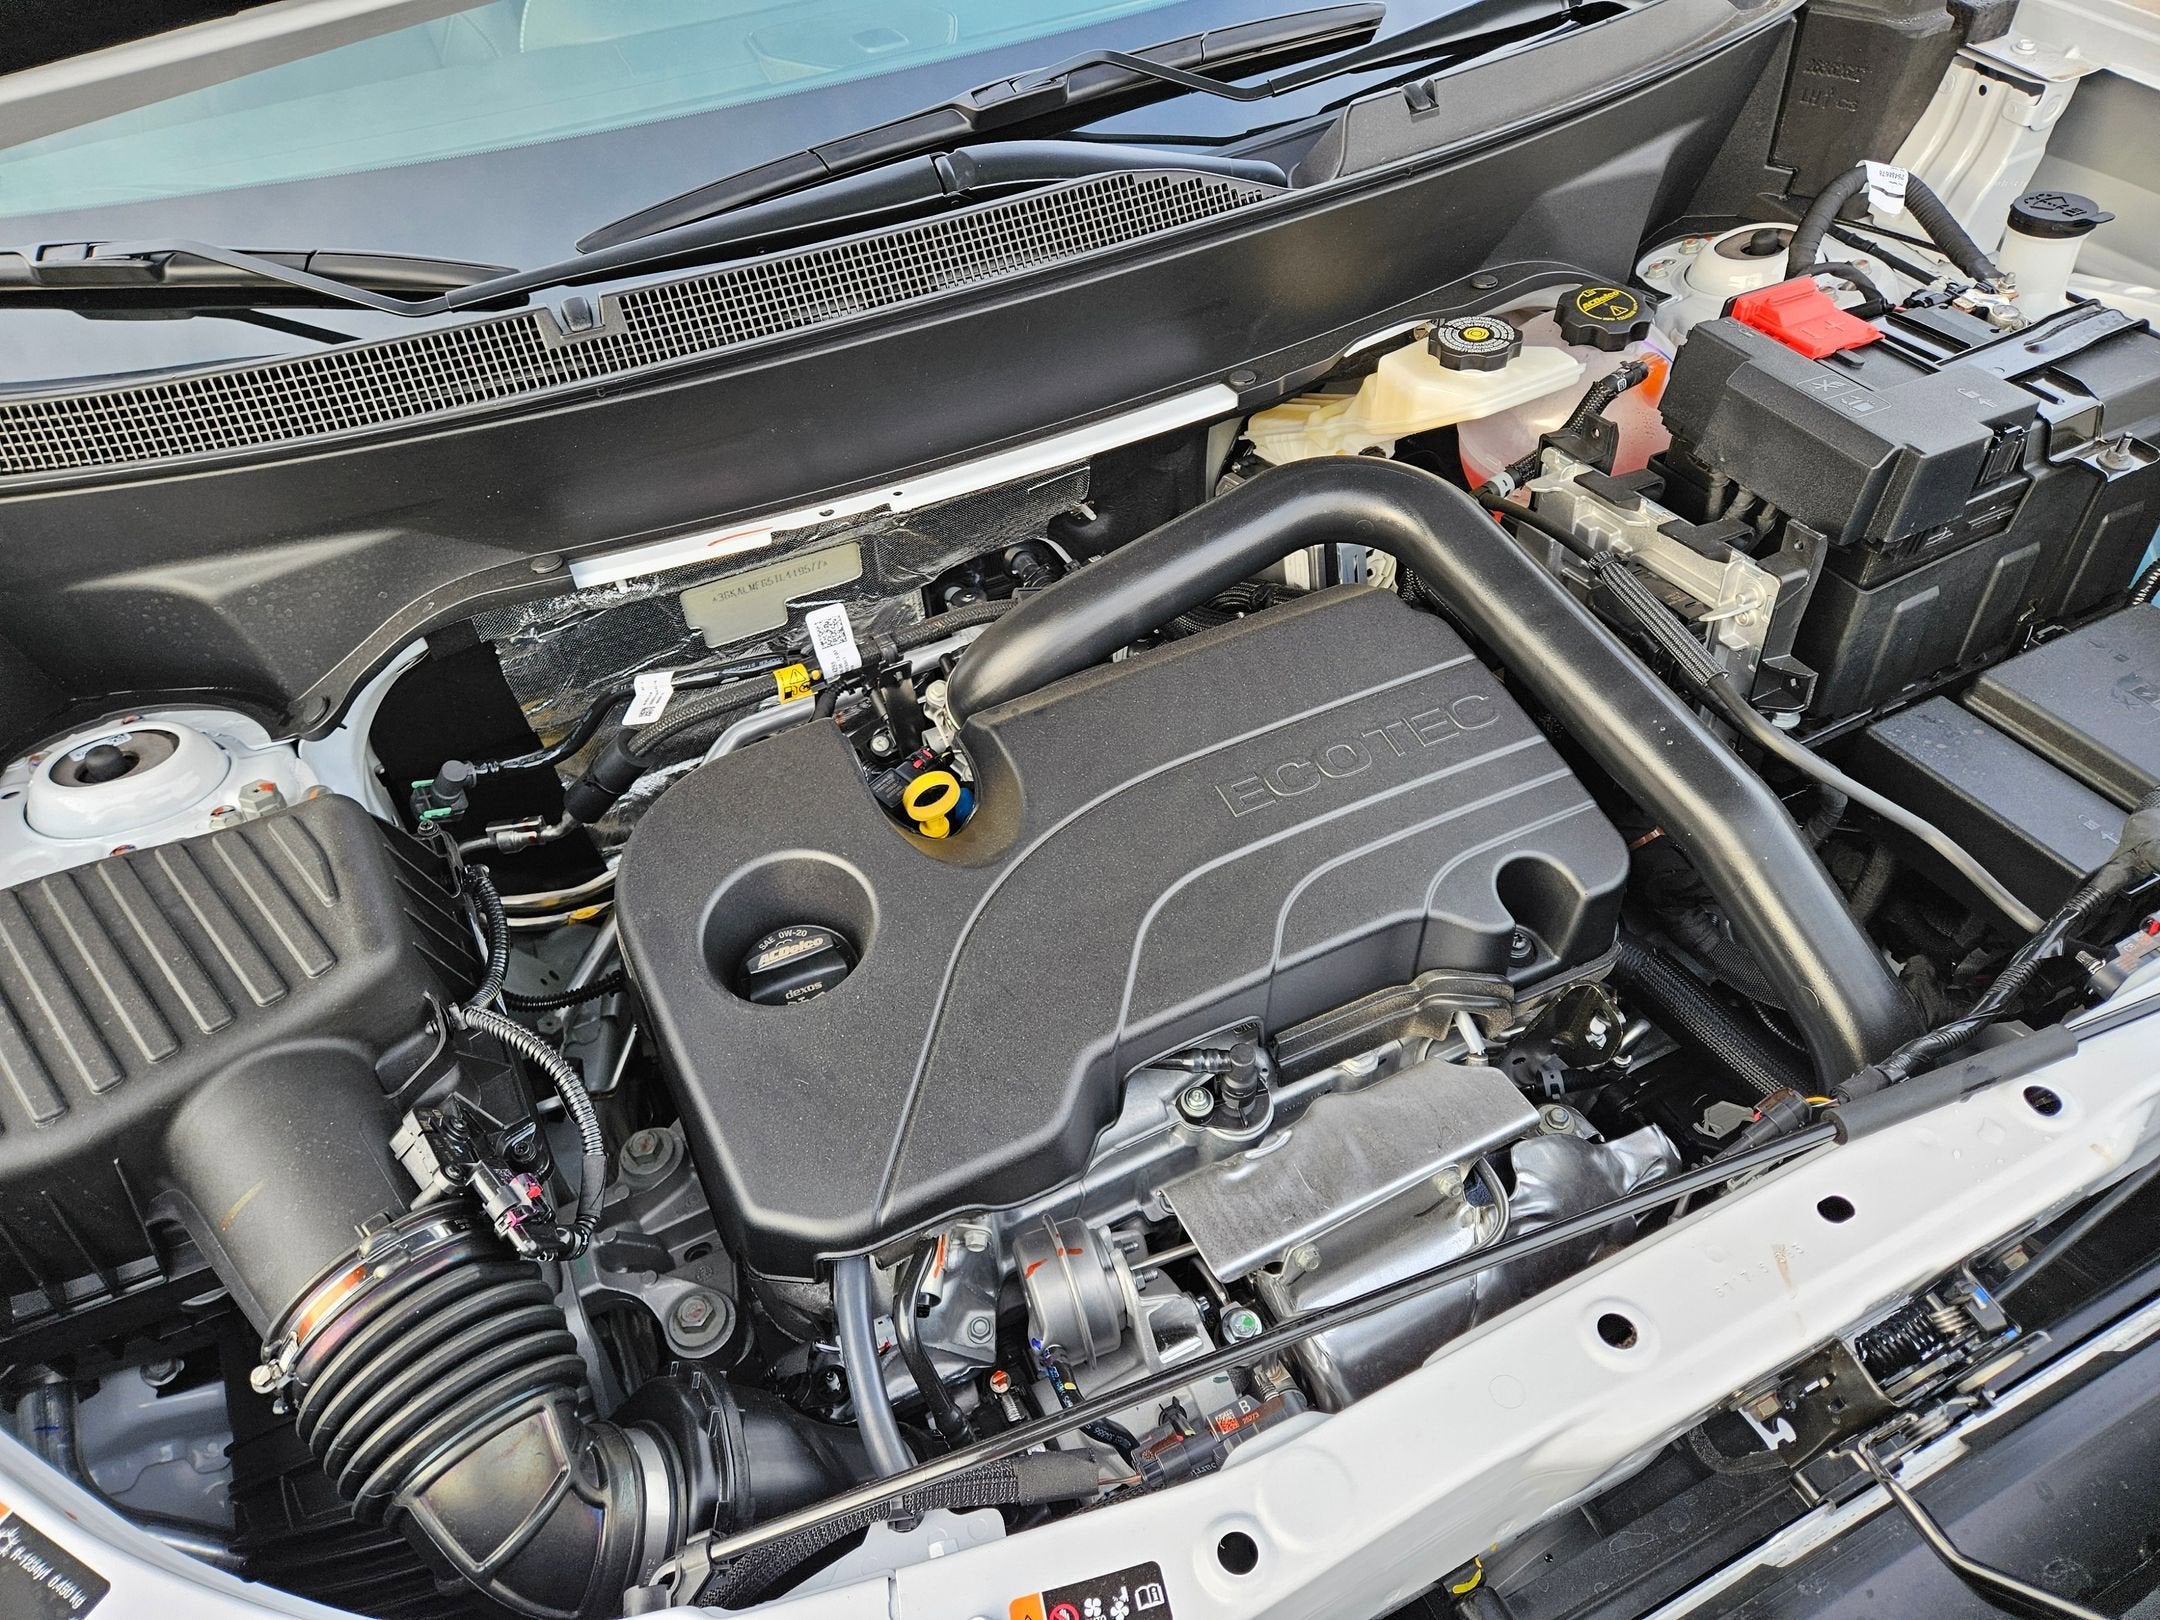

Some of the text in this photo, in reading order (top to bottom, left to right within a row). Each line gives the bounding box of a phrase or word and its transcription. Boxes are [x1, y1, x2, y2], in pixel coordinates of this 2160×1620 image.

[1582, 290, 1620, 310] ACDelco
[1215, 695, 1499, 817] ECOTEC
[758, 929, 808, 951] SAE 0W-20
[757, 937, 824, 967] ACDelco
[785, 981, 823, 1000] dexos
[1238, 1400, 1252, 1415] B
[10, 1546, 54, 1581] R-1234yf
